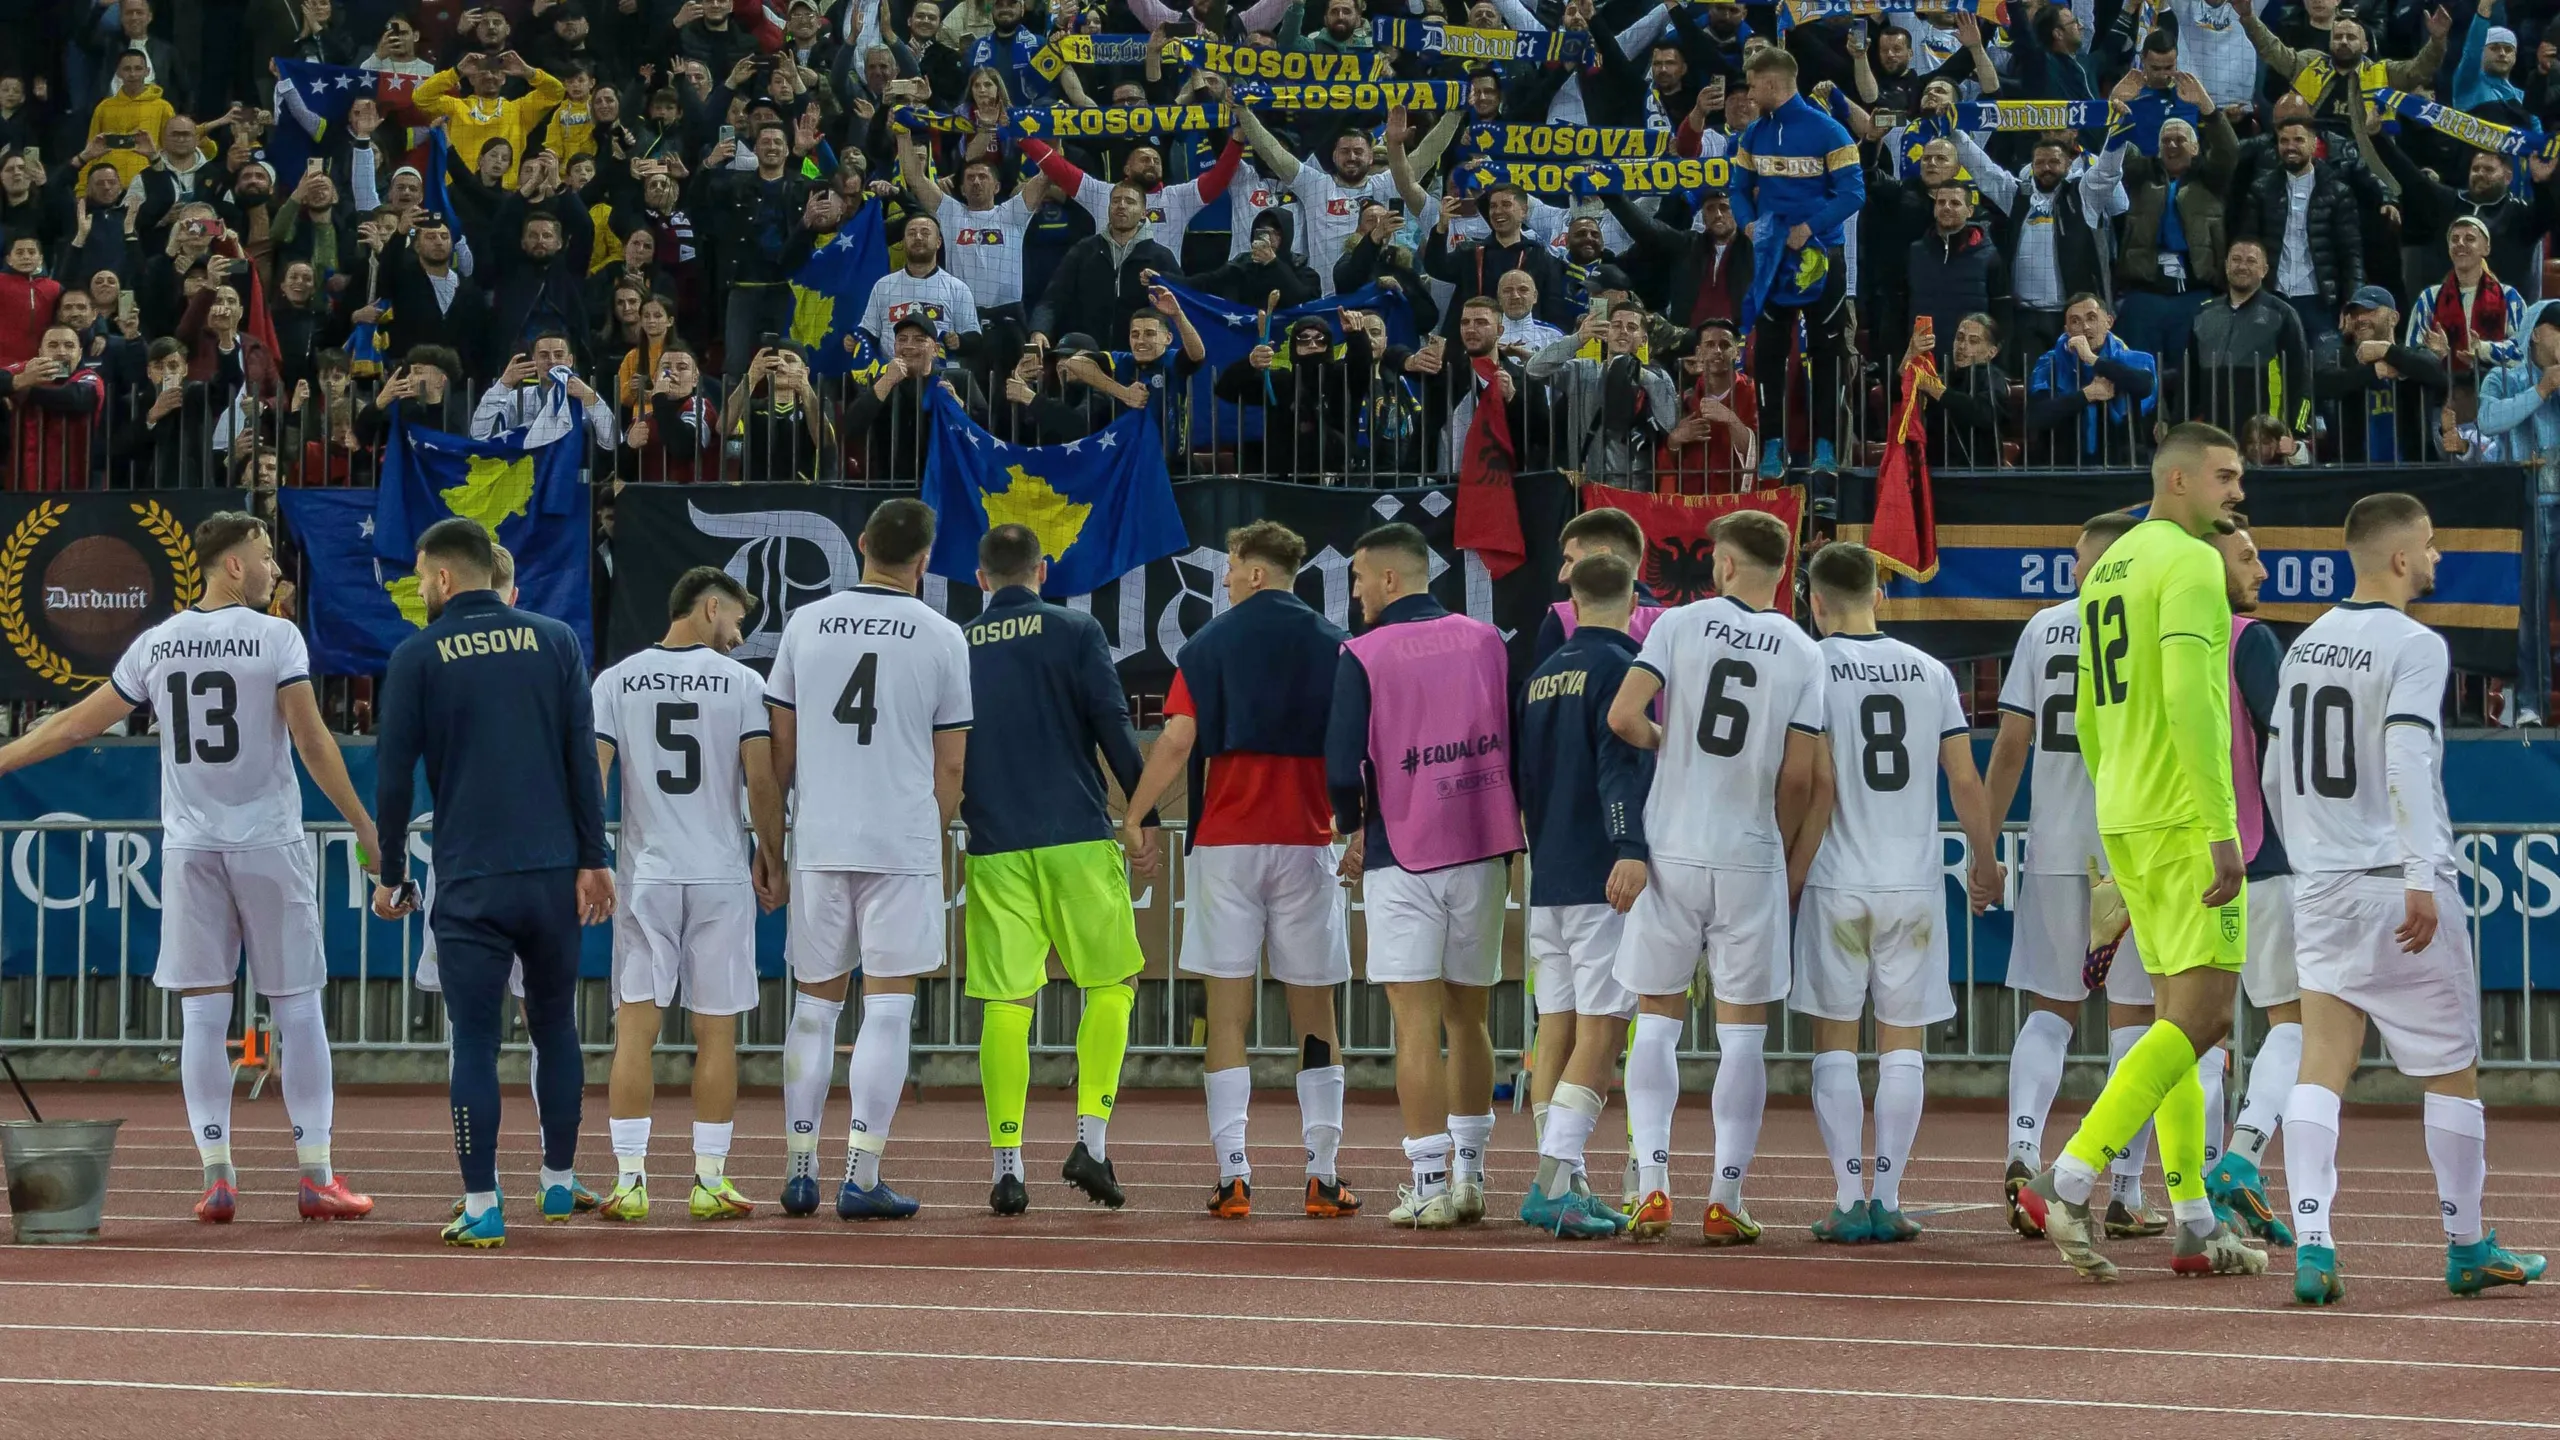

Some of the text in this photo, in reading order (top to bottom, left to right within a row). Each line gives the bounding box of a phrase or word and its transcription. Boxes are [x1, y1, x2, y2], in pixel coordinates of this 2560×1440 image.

[1422, 23, 1538, 58] Dardanët
[1204, 43, 1361, 81] KOSOVA
[1272, 82, 1437, 110] KOSOVA
[1051, 105, 1210, 136] KOSOVA
[1977, 101, 2088, 130] Dardanët
[1504, 124, 1647, 157] KOSOVA
[1507, 163, 1585, 193] KOS
[1622, 157, 1729, 191] KOSO
[2277, 556, 2334, 597] 08
[45, 587, 148, 610] Dardanët
[437, 627, 539, 663] KOSOVA
[818, 617, 917, 640] KRYEZIU
[1704, 619, 1781, 656] FAZLIJI
[150, 639, 261, 664] RRAHMANI
[2086, 594, 2130, 707] 12
[622, 673, 729, 695] KASTRATI
[1528, 670, 1588, 704] KOSOVA
[1831, 664, 1926, 684] MUSLIJA
[832, 652, 878, 746] 4
[1697, 657, 1758, 758] 6
[2041, 654, 2079, 753] 2
[167, 670, 240, 764] 13
[656, 702, 701, 795] 5
[1401, 733, 1504, 776] #EQUALGA
[1860, 694, 1911, 792] 8
[2289, 682, 2357, 800] 10
